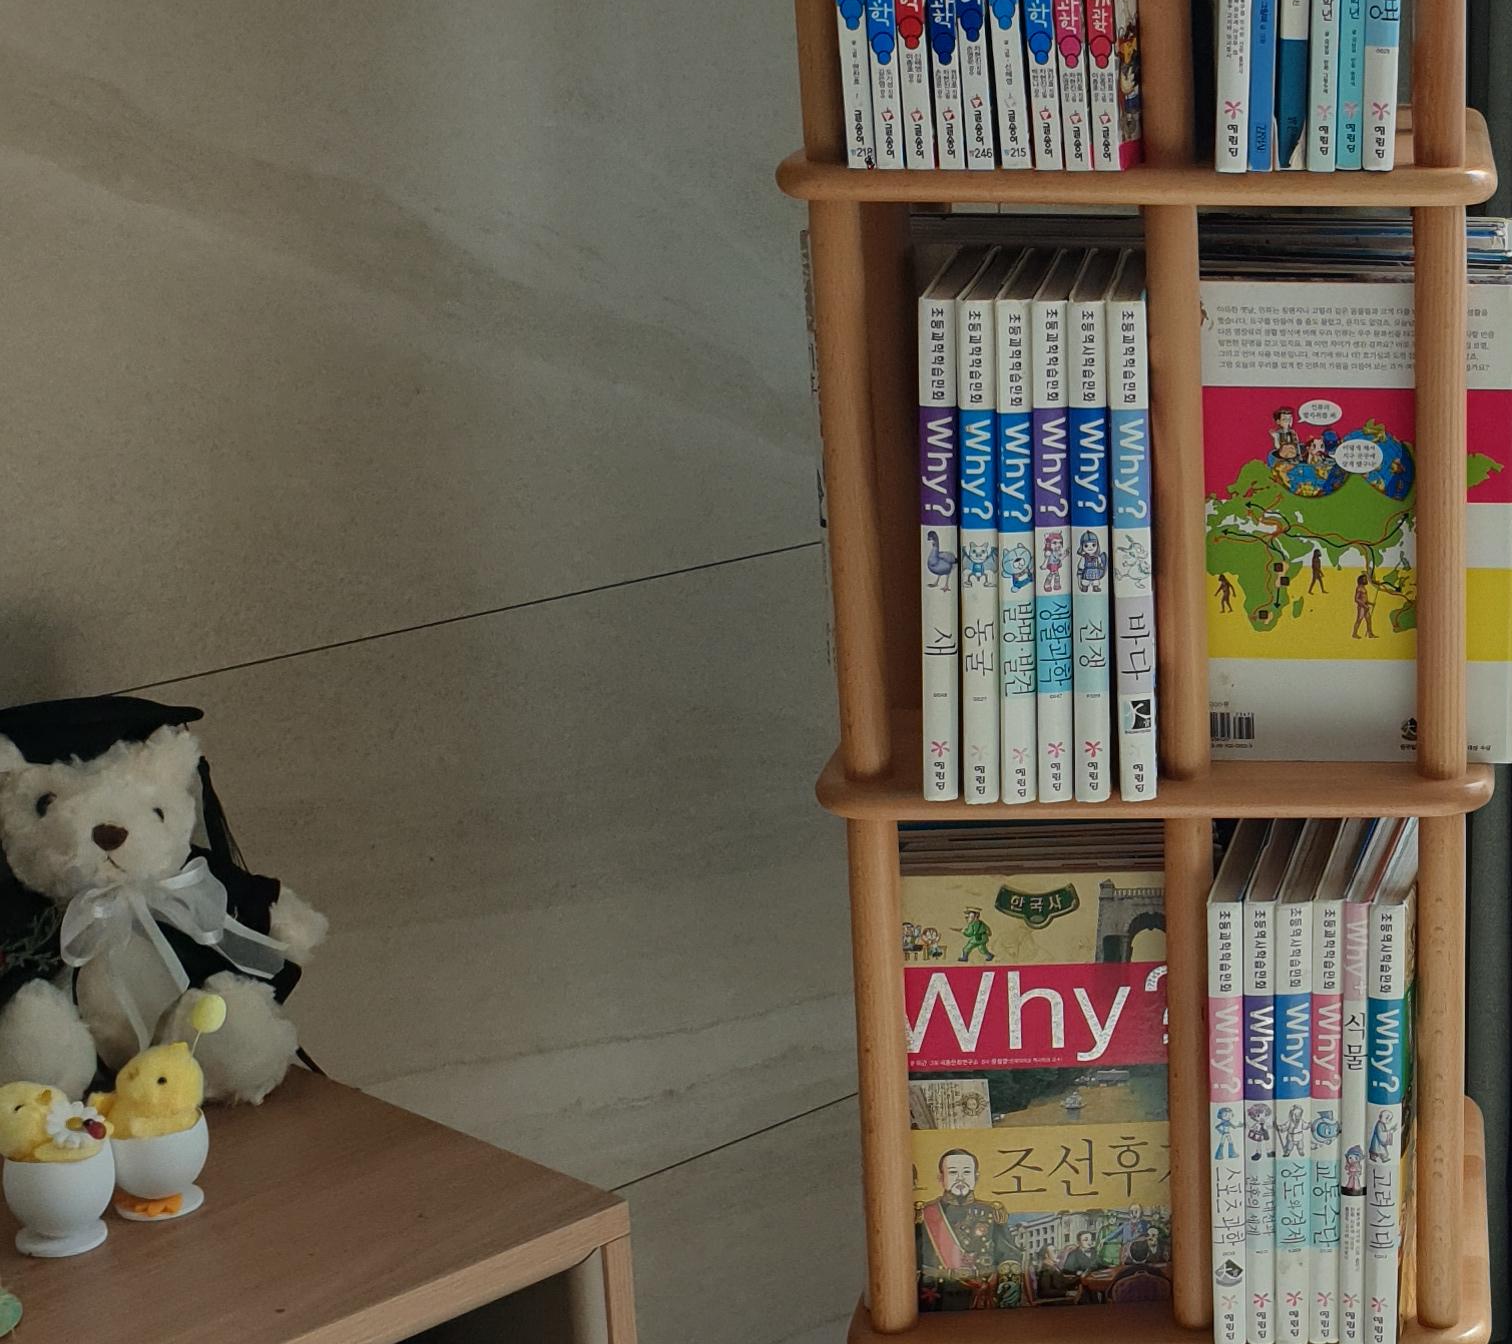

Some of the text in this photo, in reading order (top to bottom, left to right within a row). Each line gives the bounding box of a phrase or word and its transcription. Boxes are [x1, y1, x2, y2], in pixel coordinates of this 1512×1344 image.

[930, 307, 945, 401] 초등과학학습만화
[968, 310, 983, 404] 초등과학학습만화
[1008, 313, 1023, 407] 초등과학학습만화
[1045, 308, 1059, 402] 초등과학학습만화
[1080, 310, 1096, 402] 초등역사학습만화
[1121, 310, 1136, 404] 초등과학학습만화
[922, 416, 956, 517] Why?
[961, 419, 994, 520] Why?
[1000, 422, 1032, 523] Why?
[1036, 416, 1069, 517] Why?
[1074, 418, 1107, 514] Why?
[1115, 418, 1147, 519] Why?
[924, 627, 959, 656] 새
[964, 619, 995, 677] 동굴
[1039, 601, 1072, 686] 생활과학
[1078, 618, 1106, 669] 전쟁
[1120, 613, 1152, 681] 바다
[1010, 894, 1063, 913] 한국사
[1218, 911, 1232, 993] 초등과학학습만화
[1253, 910, 1267, 990] 초등역사학습만화
[1289, 908, 1303, 988] 초등역사학습만화
[1323, 909, 1336, 990] 초등과학학습만화
[1380, 913, 1393, 994] 초등역사학습만화
[1211, 1005, 1242, 1094] Why?
[1245, 1005, 1275, 1091] Why?
[1280, 1002, 1310, 1088] Why?
[1313, 1002, 1342, 1092] Why?
[1343, 1012, 1368, 1071] 식물
[1370, 1008, 1401, 1094] Why?
[1313, 1161, 1341, 1248] 교통수단
[1369, 1167, 1395, 1250] 고려시대
